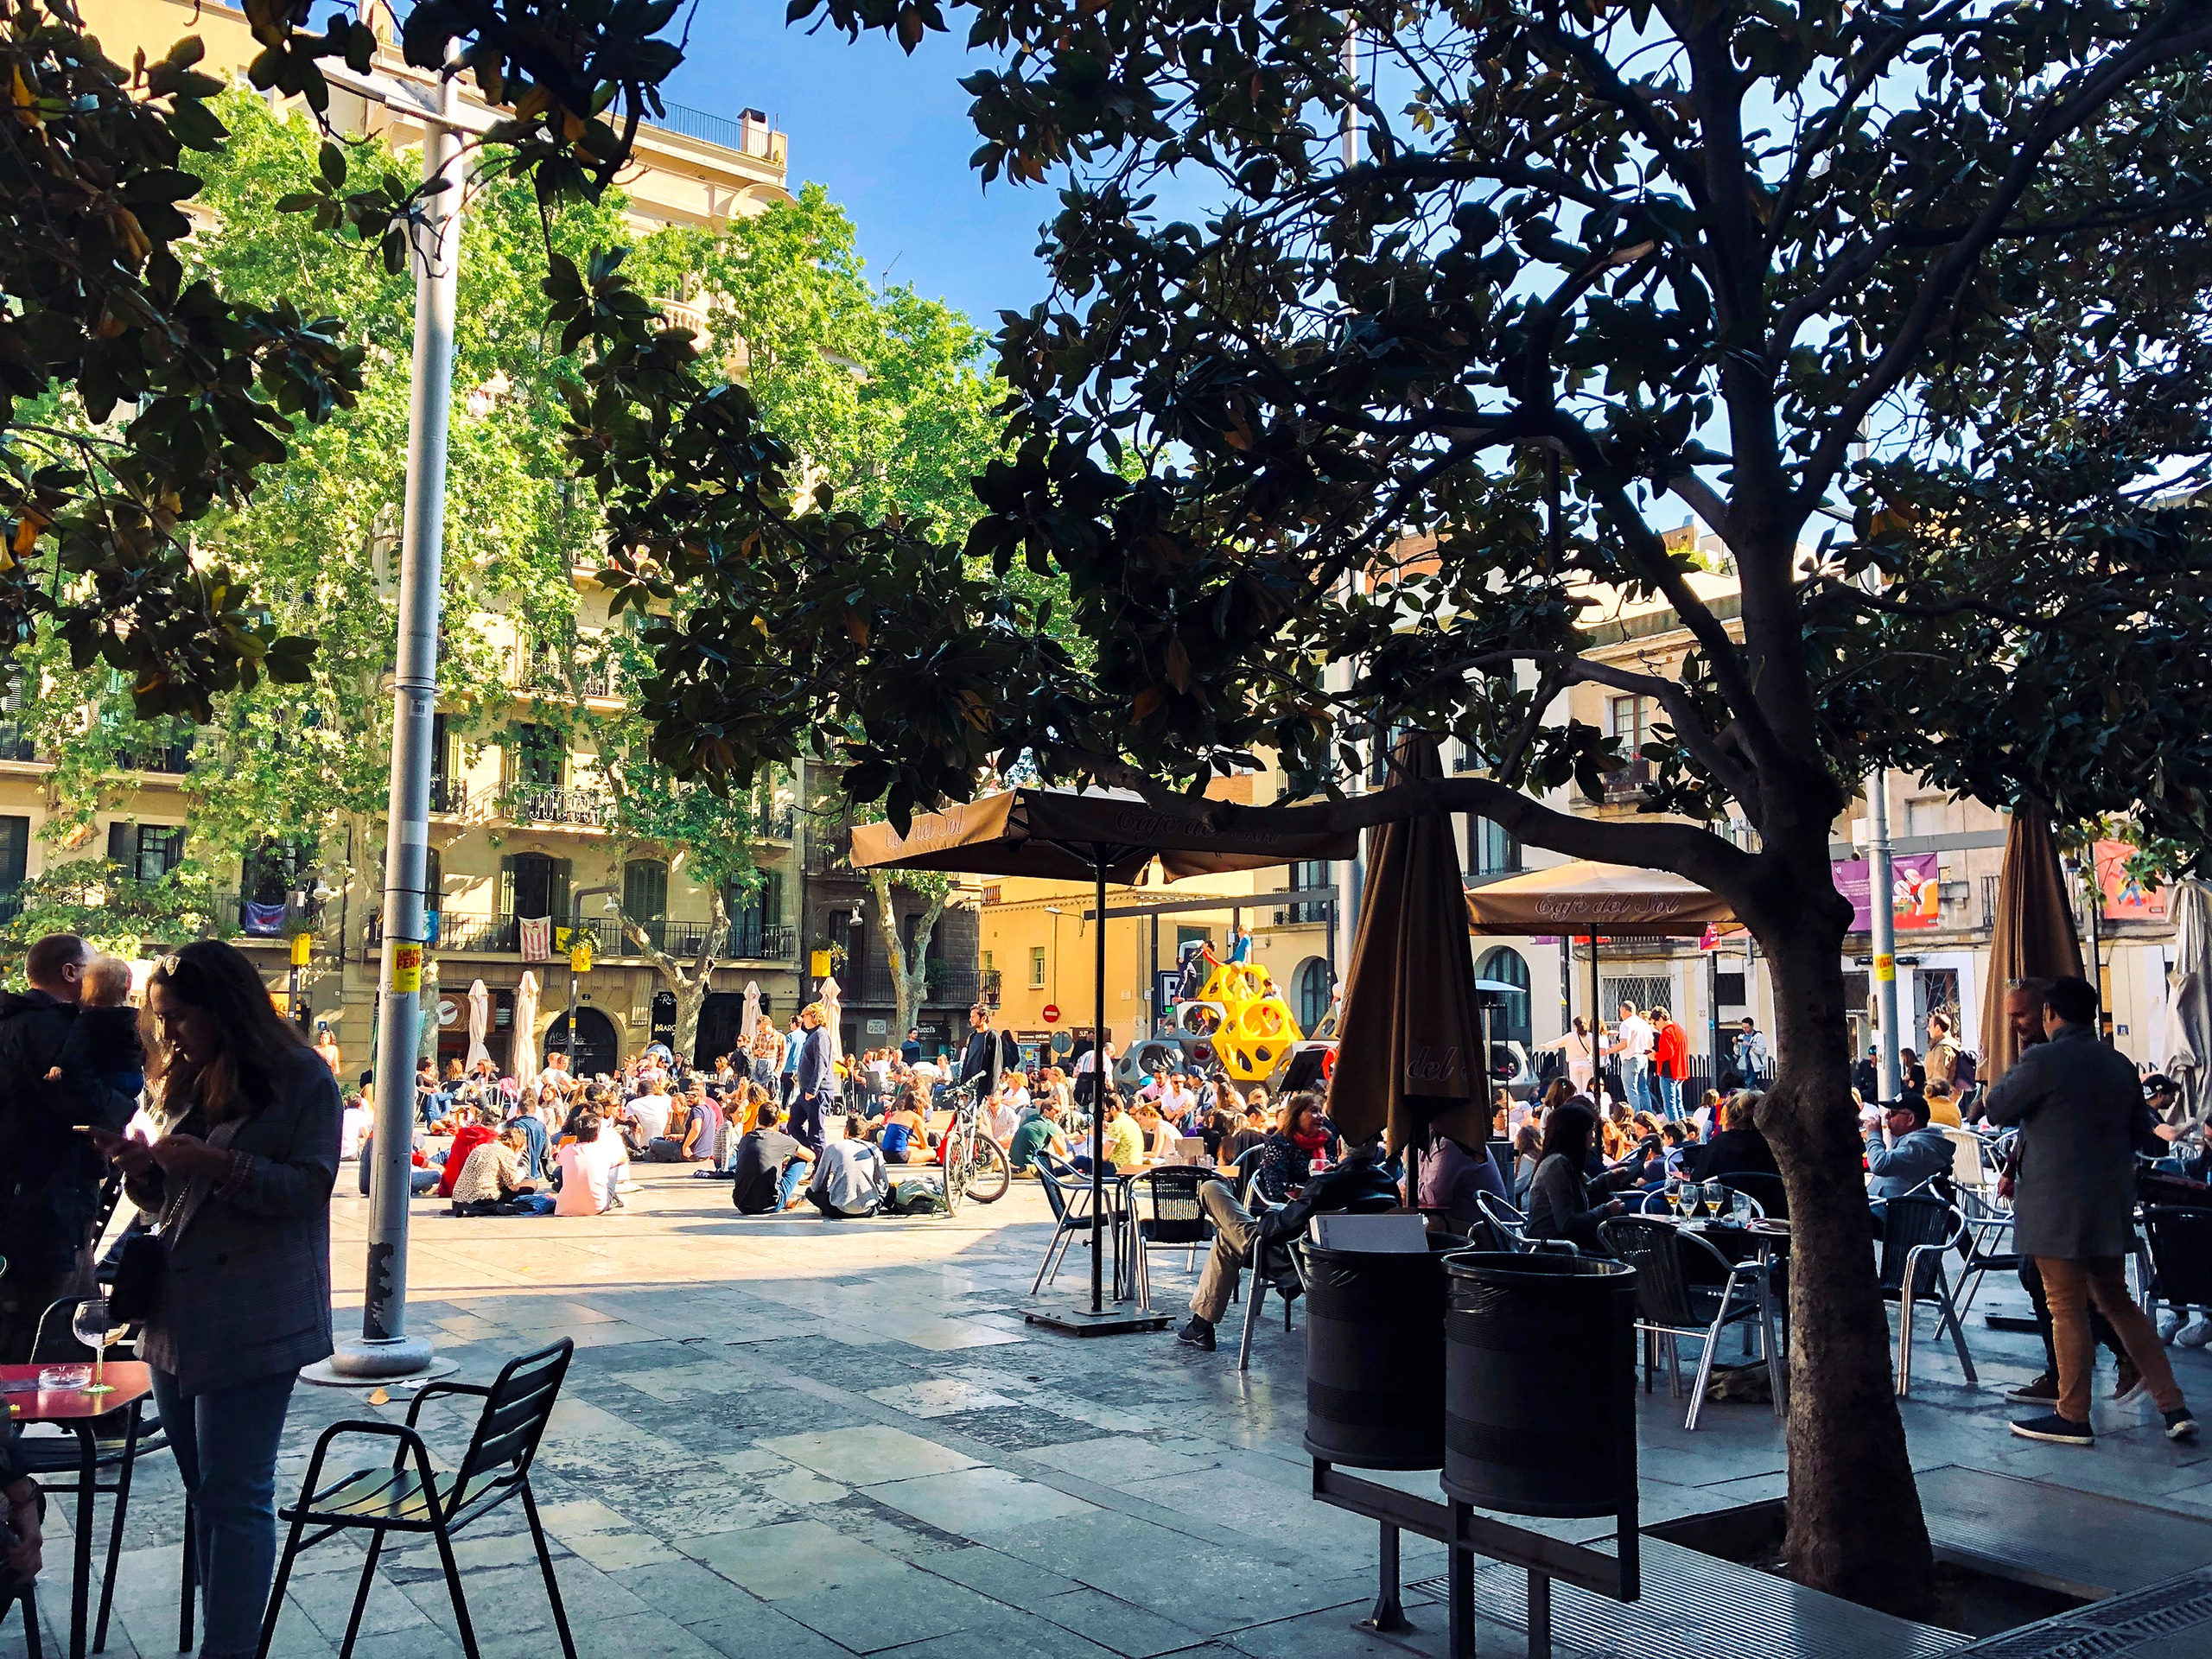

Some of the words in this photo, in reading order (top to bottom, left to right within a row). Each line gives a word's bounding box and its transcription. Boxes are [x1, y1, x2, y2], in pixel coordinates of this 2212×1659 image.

[937, 805, 965, 837] Sol
[1592, 893, 1634, 915] del
[1634, 893, 1683, 915] Sol
[1406, 1046, 1459, 1083] del
